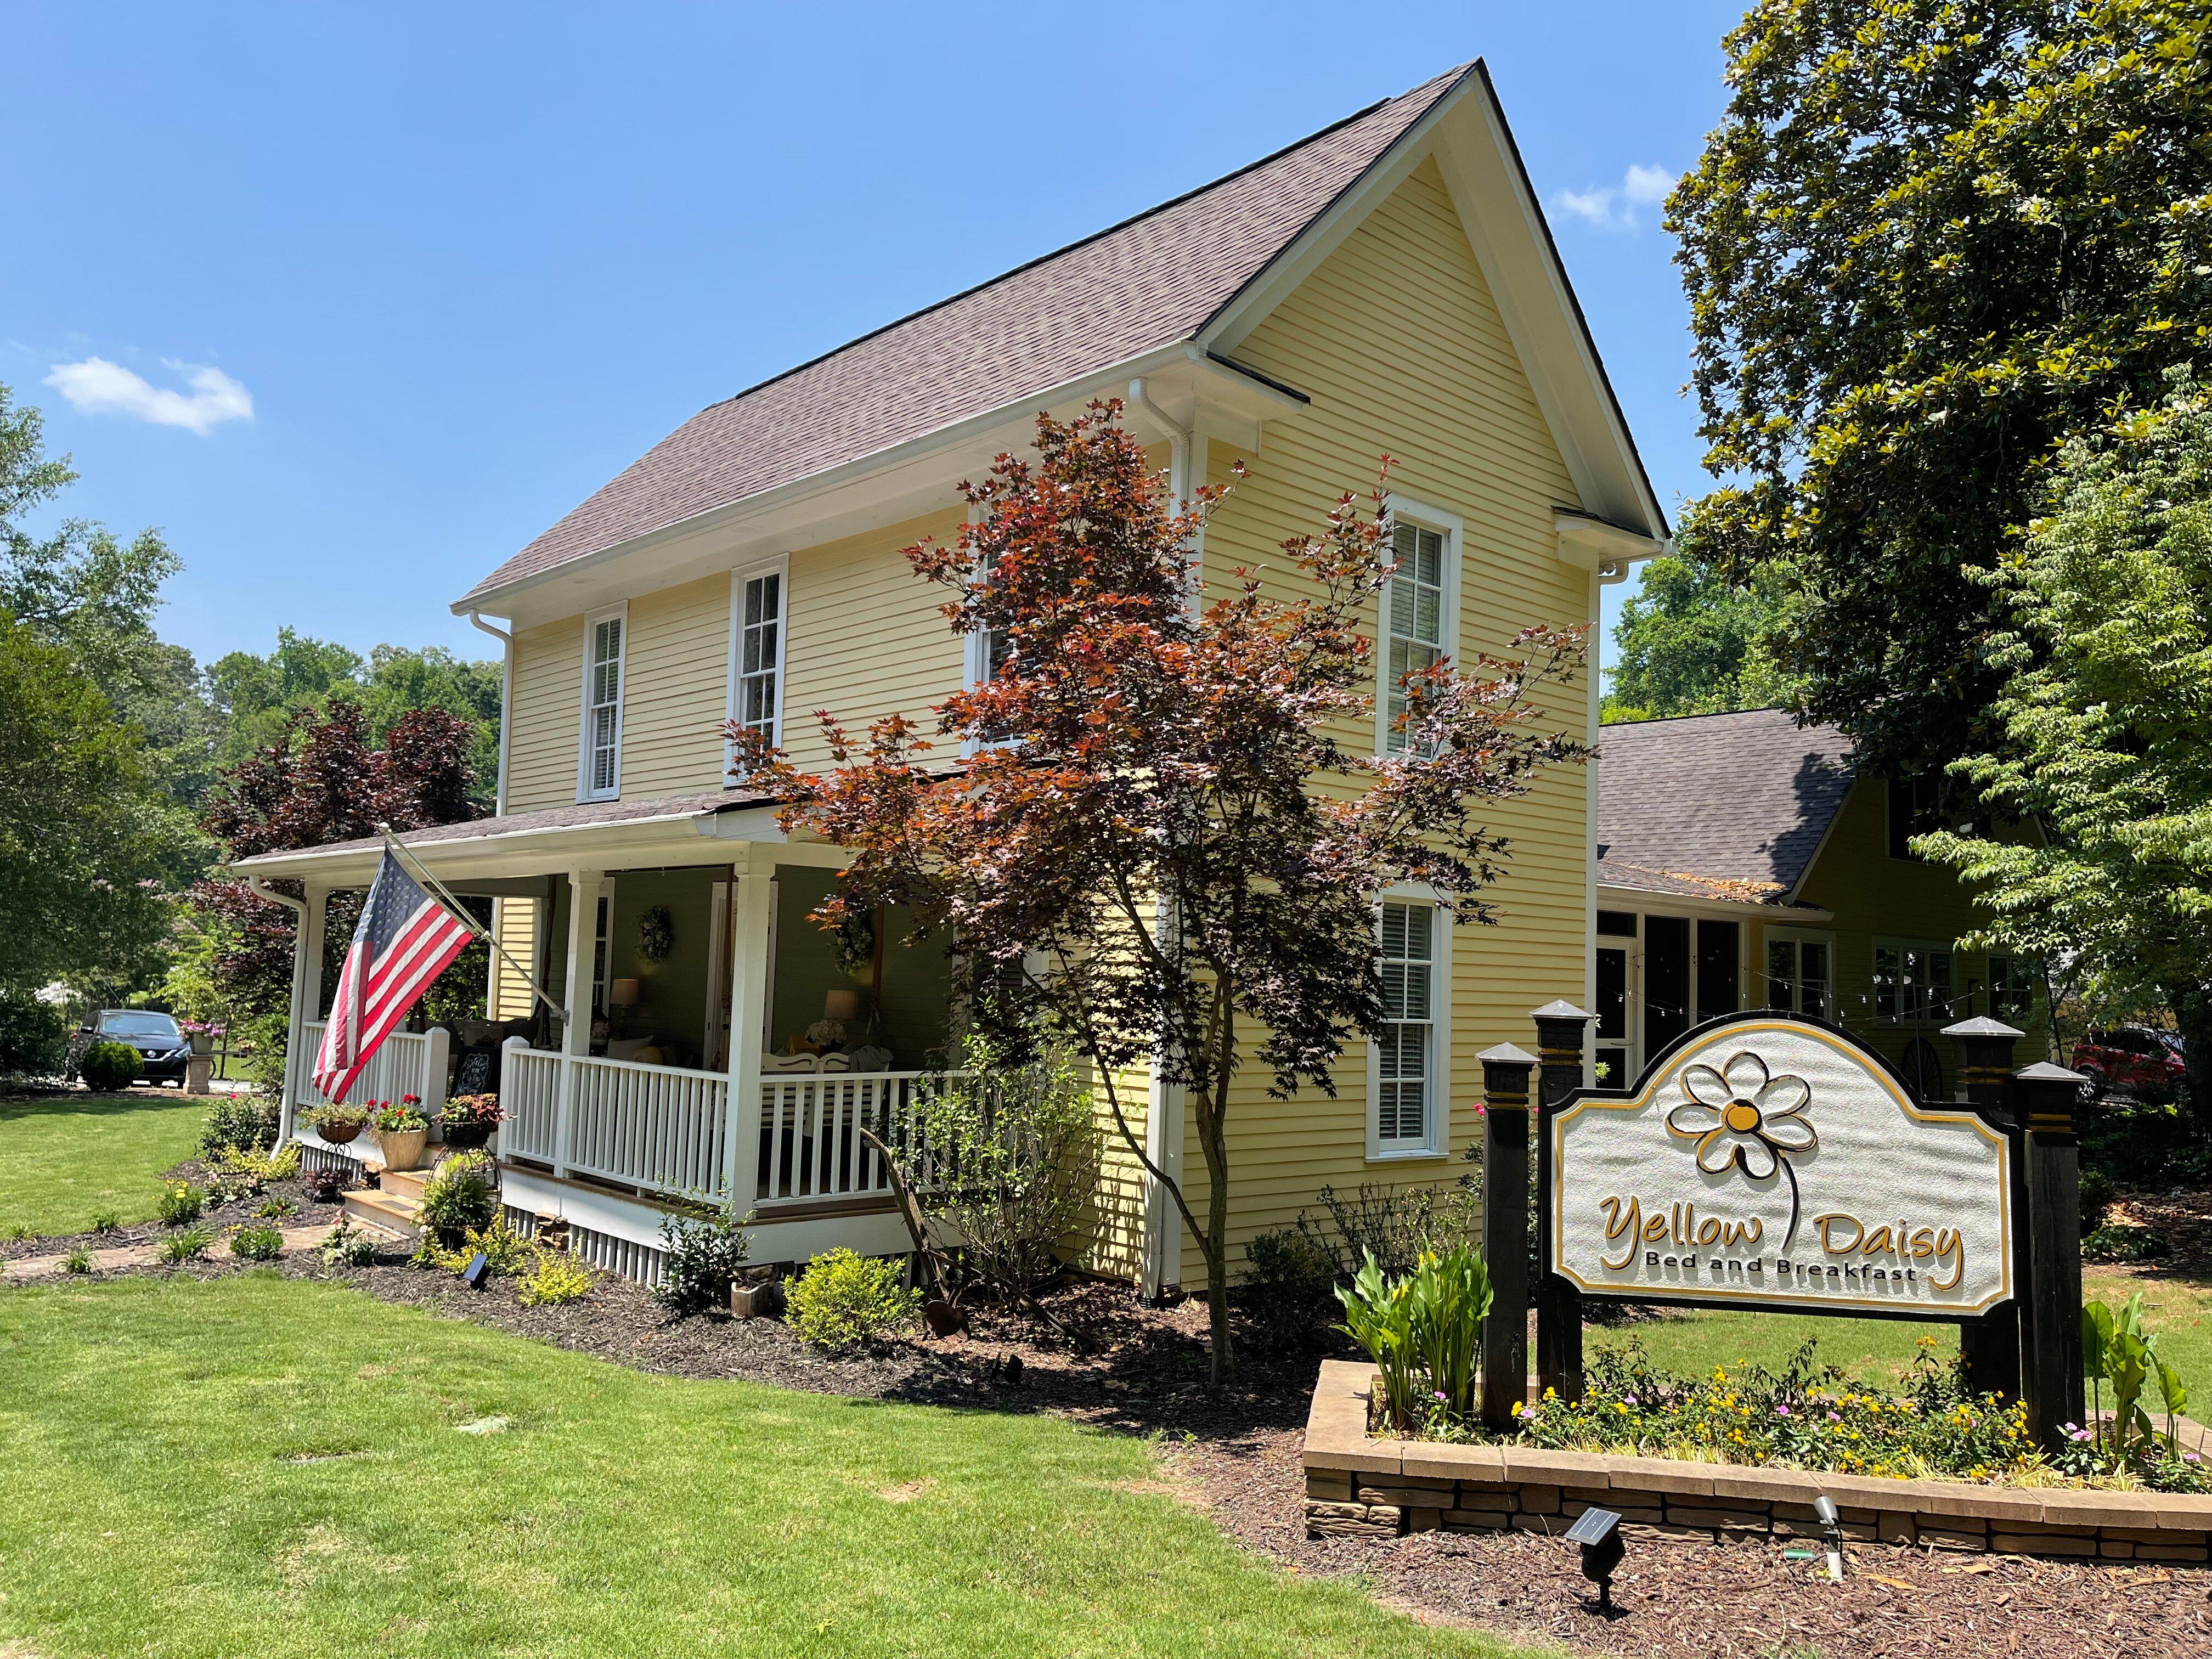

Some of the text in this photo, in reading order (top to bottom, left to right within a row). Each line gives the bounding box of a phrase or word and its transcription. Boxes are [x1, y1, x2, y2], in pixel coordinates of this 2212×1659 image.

[1599, 1195, 1963, 1290] Yellow Daisy
[1646, 1251, 1916, 1281] Bed and Breakfast
